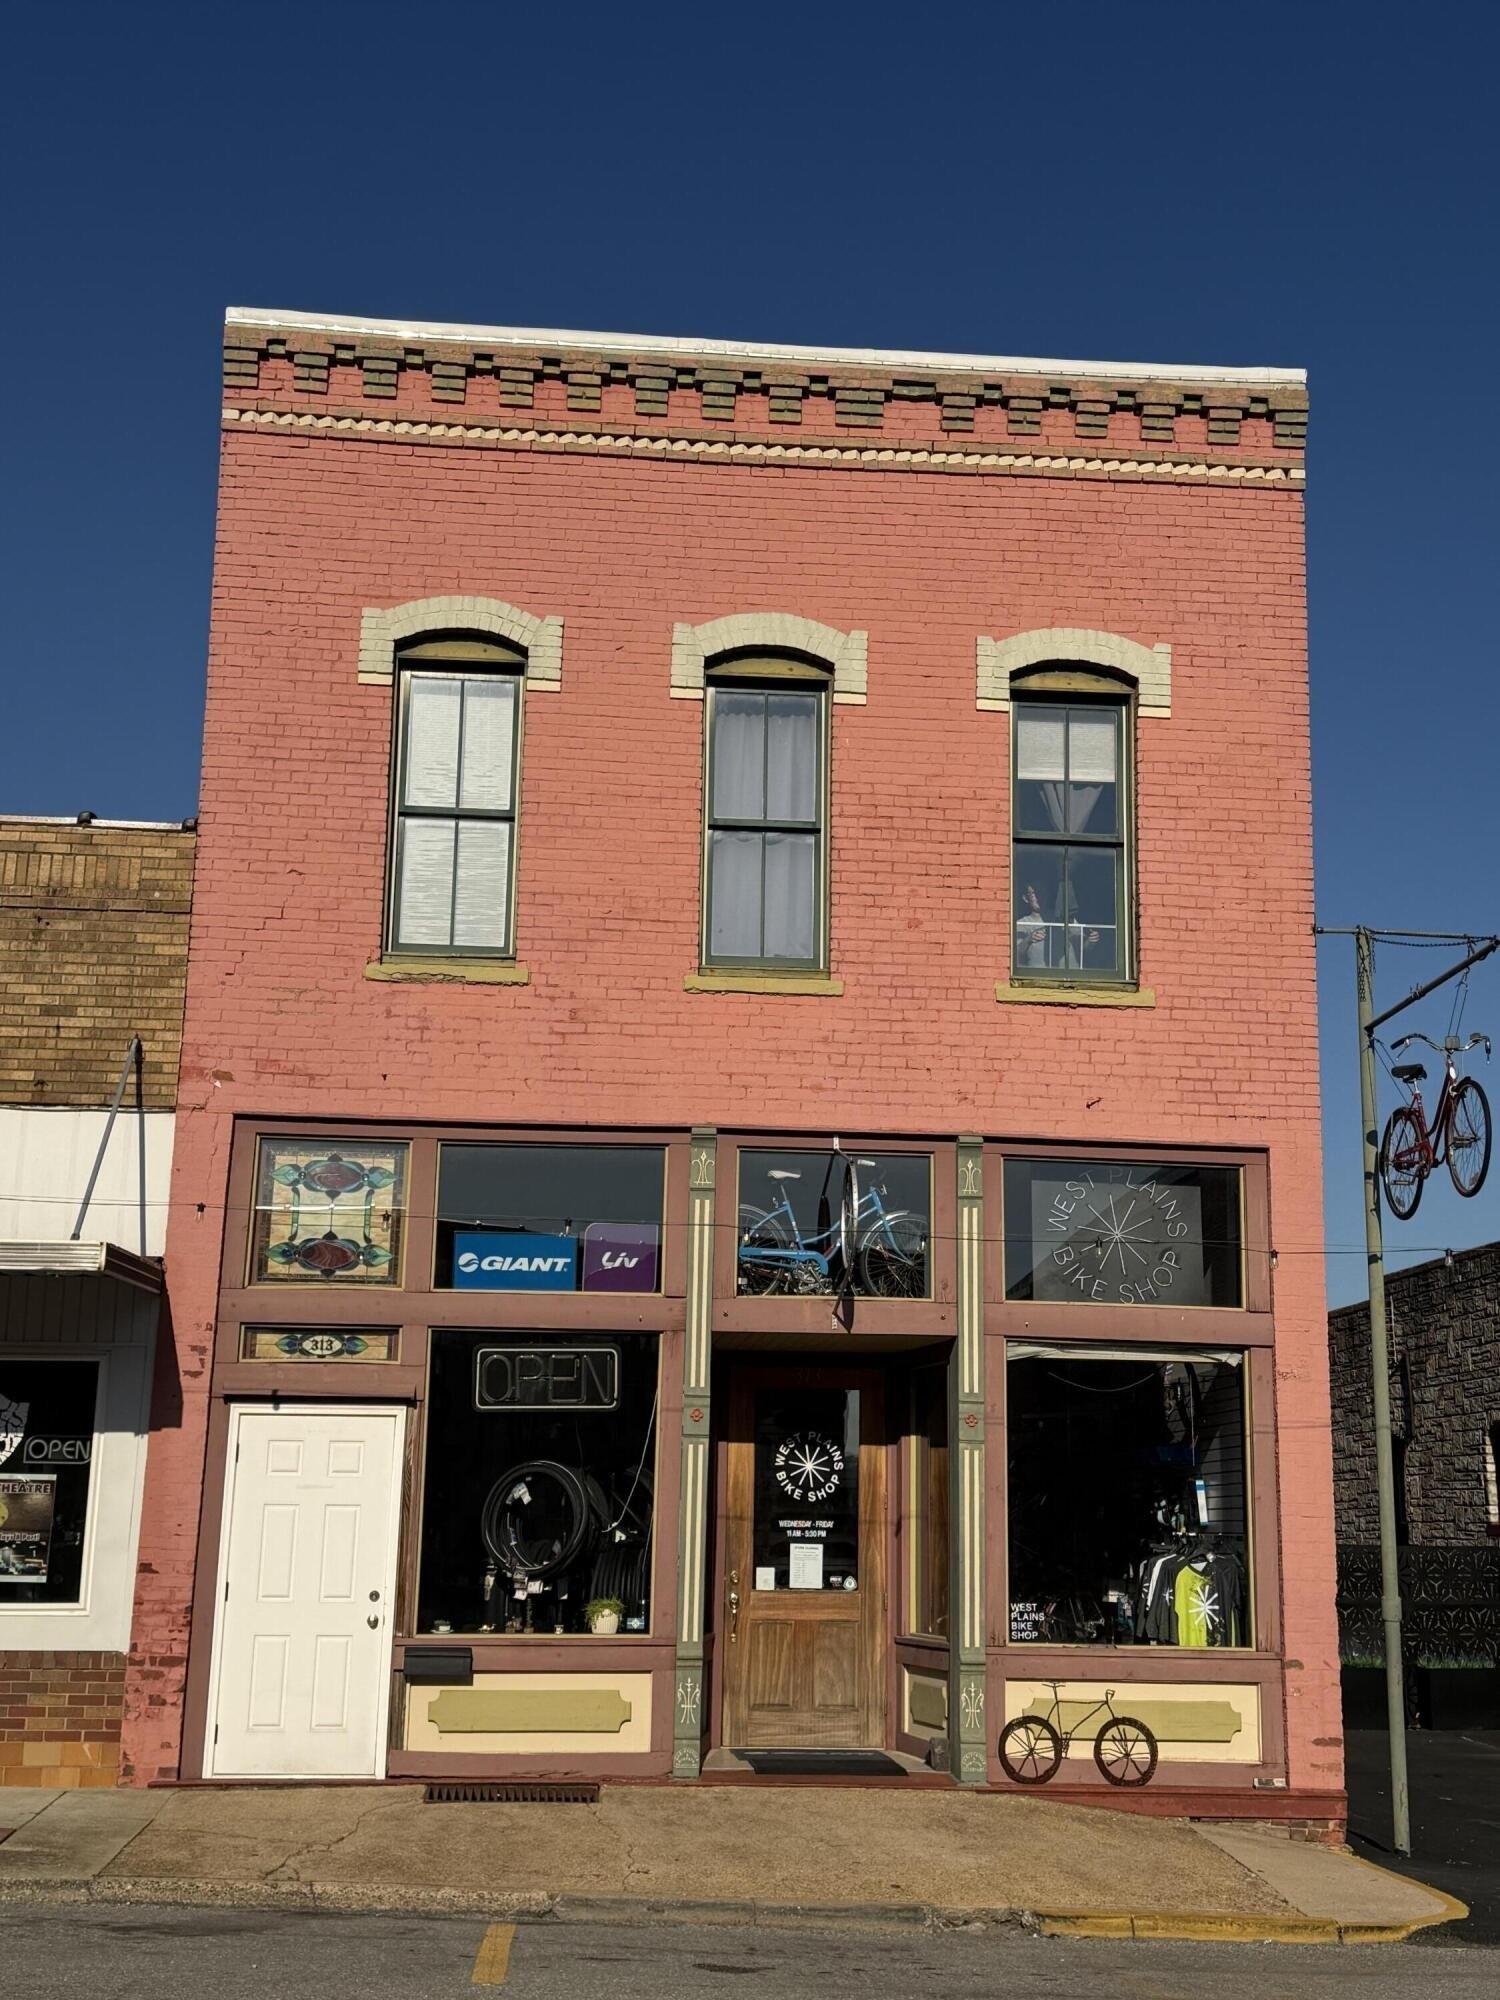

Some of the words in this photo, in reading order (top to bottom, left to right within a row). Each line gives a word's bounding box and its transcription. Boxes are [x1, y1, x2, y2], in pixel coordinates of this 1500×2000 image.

[1046, 1169, 1095, 1232] WEST
[1109, 1166, 1188, 1237] PLAINS
[480, 1255, 571, 1272] GIANT
[601, 1251, 640, 1269] Liv
[1053, 1246, 1108, 1300] BIKE
[1119, 1250, 1182, 1304] SHOP
[311, 1338, 333, 1351] 313
[481, 1354, 612, 1404] OPEN
[28, 1439, 91, 1460] OPEN
[774, 1432, 801, 1466] WEST
[808, 1431, 844, 1470] PLAINS
[0, 1482, 50, 1494] HEATRE
[776, 1471, 803, 1500] BIKE
[807, 1474, 840, 1502] SHOP
[778, 1520, 812, 1528] WEDNESDAY
[815, 1520, 834, 1528] FRIDAY
[817, 1530, 827, 1538] PM
[1010, 1602, 1037, 1612] WEST
[1011, 1612, 1045, 1621] PLAINS
[1011, 1621, 1033, 1631] BIKE
[1011, 1631, 1038, 1640] SHOP
